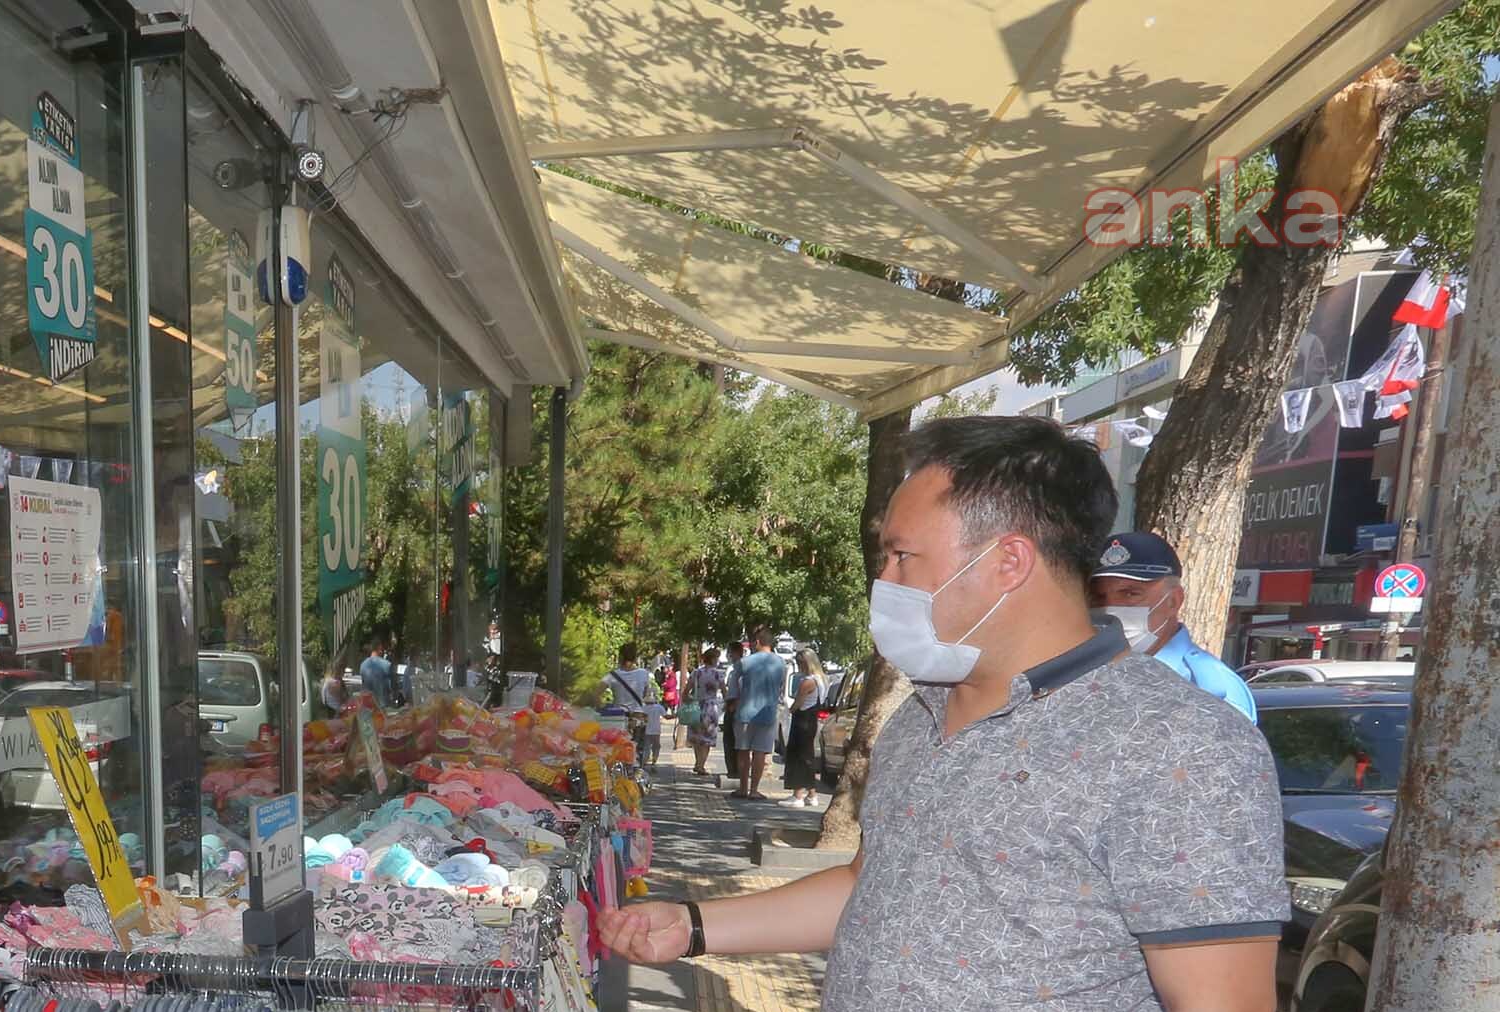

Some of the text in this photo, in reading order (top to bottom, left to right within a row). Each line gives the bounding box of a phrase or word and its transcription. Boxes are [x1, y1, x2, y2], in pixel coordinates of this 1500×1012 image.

[32, 227, 86, 329] 30
[227, 329, 253, 394] 50
[322, 447, 361, 571] 30
[1280, 483, 1324, 520] DEMEK
